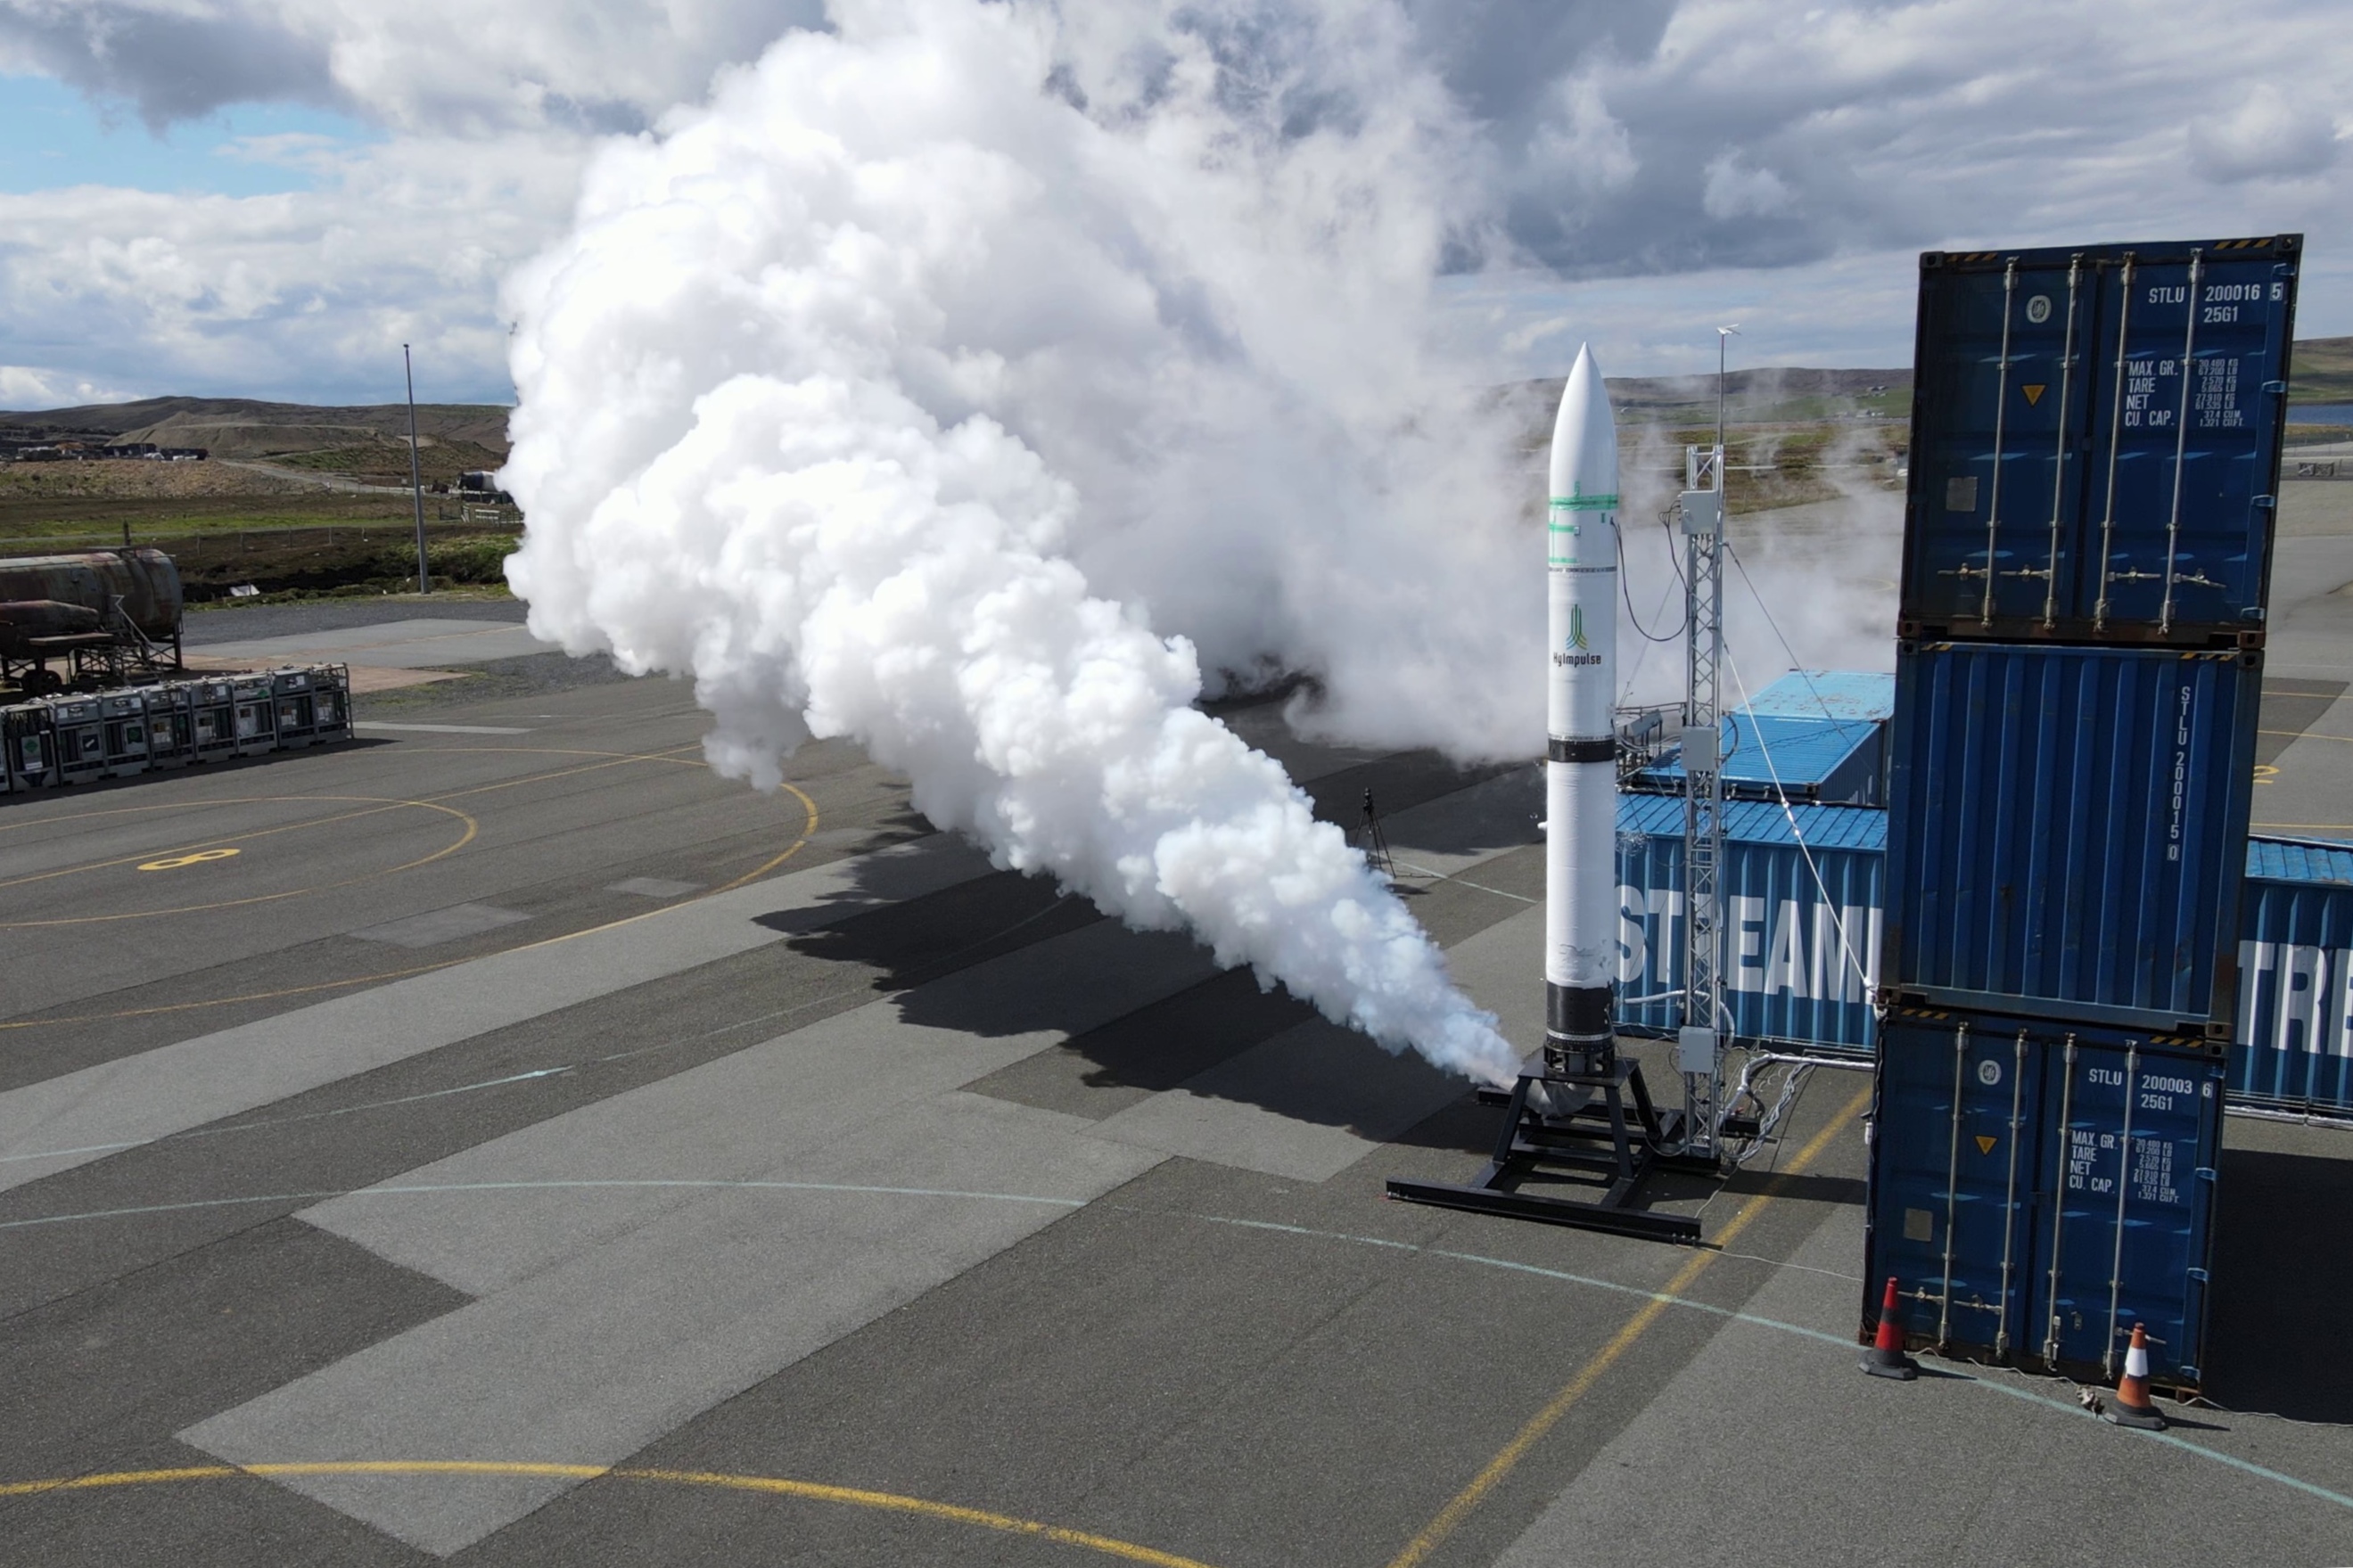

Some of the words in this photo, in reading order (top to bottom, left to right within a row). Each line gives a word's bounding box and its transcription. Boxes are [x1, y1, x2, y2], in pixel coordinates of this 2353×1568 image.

[2149, 286, 2184, 303] STLU
[2205, 283, 2261, 301] 200016
[2271, 283, 2283, 300] 5
[2204, 306, 2238, 323] 25G1
[2128, 360, 2157, 376] MAX.
[2160, 360, 2178, 375] GR.
[2228, 358, 2239, 366] KG
[2227, 367, 2238, 375] LB
[2128, 377, 2156, 393] TARE
[2225, 384, 2236, 392] LB
[2226, 376, 2237, 384] KG
[2126, 394, 2150, 410] NET
[2224, 401, 2234, 409] LB
[2225, 393, 2235, 401] KG
[2125, 411, 2143, 426] CU.
[2149, 410, 2175, 426] CAP.
[1553, 653, 1601, 668] HyImpulse
[2177, 685, 2191, 745] STLU
[2170, 751, 2184, 840] 200015
[137, 849, 241, 870] 8
[2168, 845, 2178, 860] 0
[2089, 1068, 2122, 1086] STLU
[2142, 1075, 2193, 1094] 200003
[2202, 1082, 2213, 1098] 6
[2141, 1094, 2173, 1111] 25G1
[2071, 1130, 2097, 1147] MAX.
[2101, 1134, 2119, 1150] GR.
[2163, 1141, 2173, 1150] KG
[2071, 1145, 2097, 1162] TARE
[2162, 1149, 2172, 1157] LB
[2070, 1160, 2092, 1176] NET
[2161, 1163, 2171, 1172] LB
[2069, 1175, 2086, 1190] CU.
[2091, 1178, 2115, 1194] CAP.
[2160, 1179, 2170, 1187] LB
